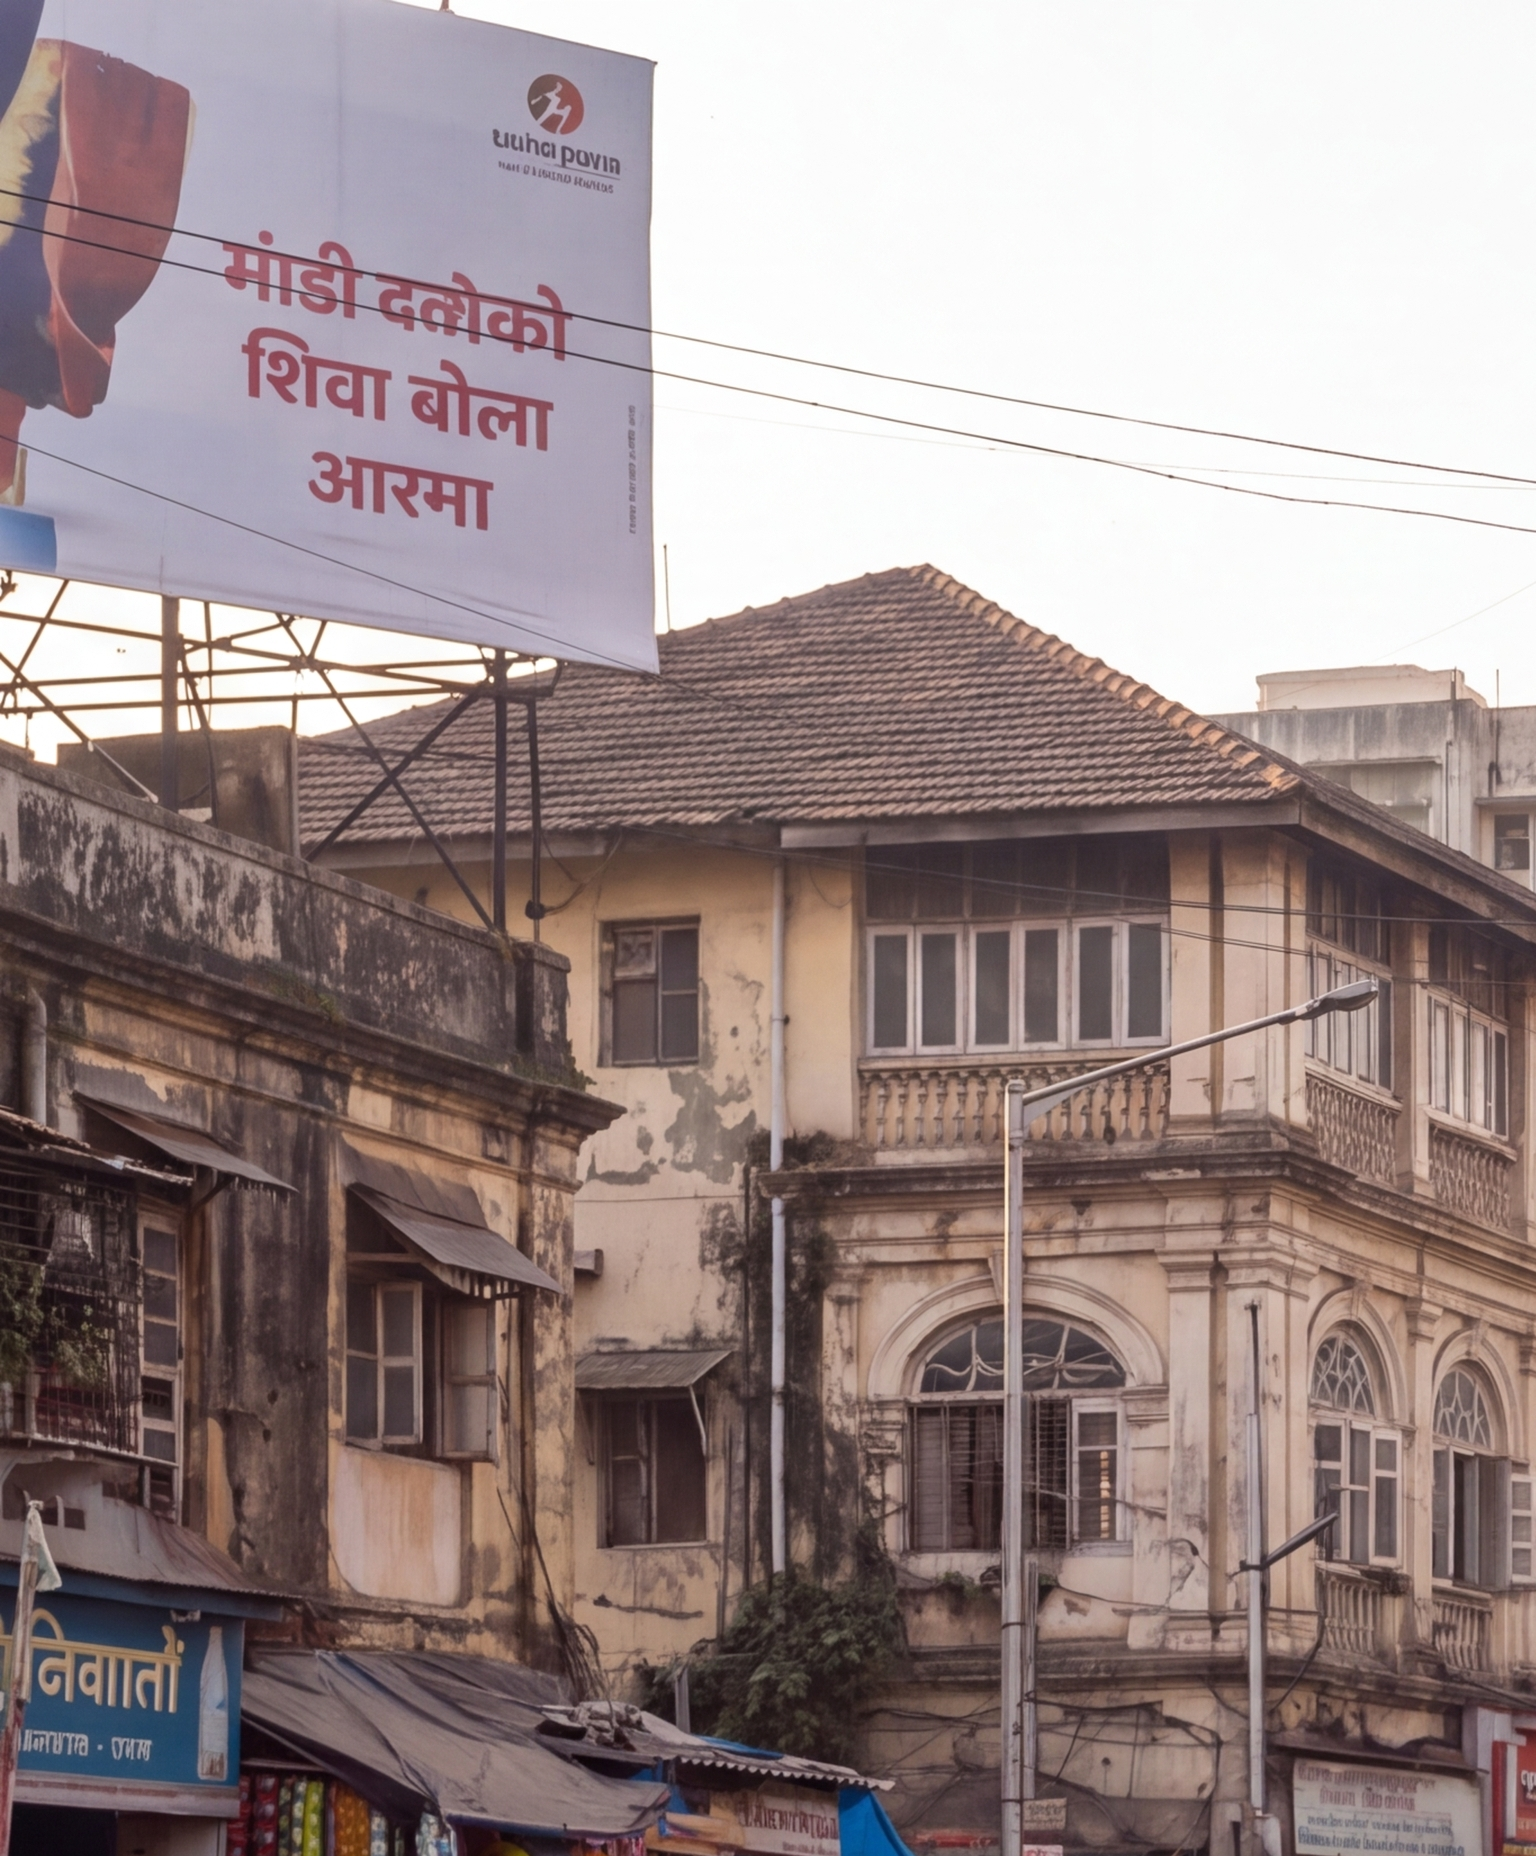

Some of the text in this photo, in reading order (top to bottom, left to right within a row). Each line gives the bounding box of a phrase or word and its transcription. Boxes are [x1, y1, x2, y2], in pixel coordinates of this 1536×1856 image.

[222, 230, 363, 319] मांडी
[241, 327, 554, 451] शिवा बोला
[308, 450, 494, 531] आरमा
